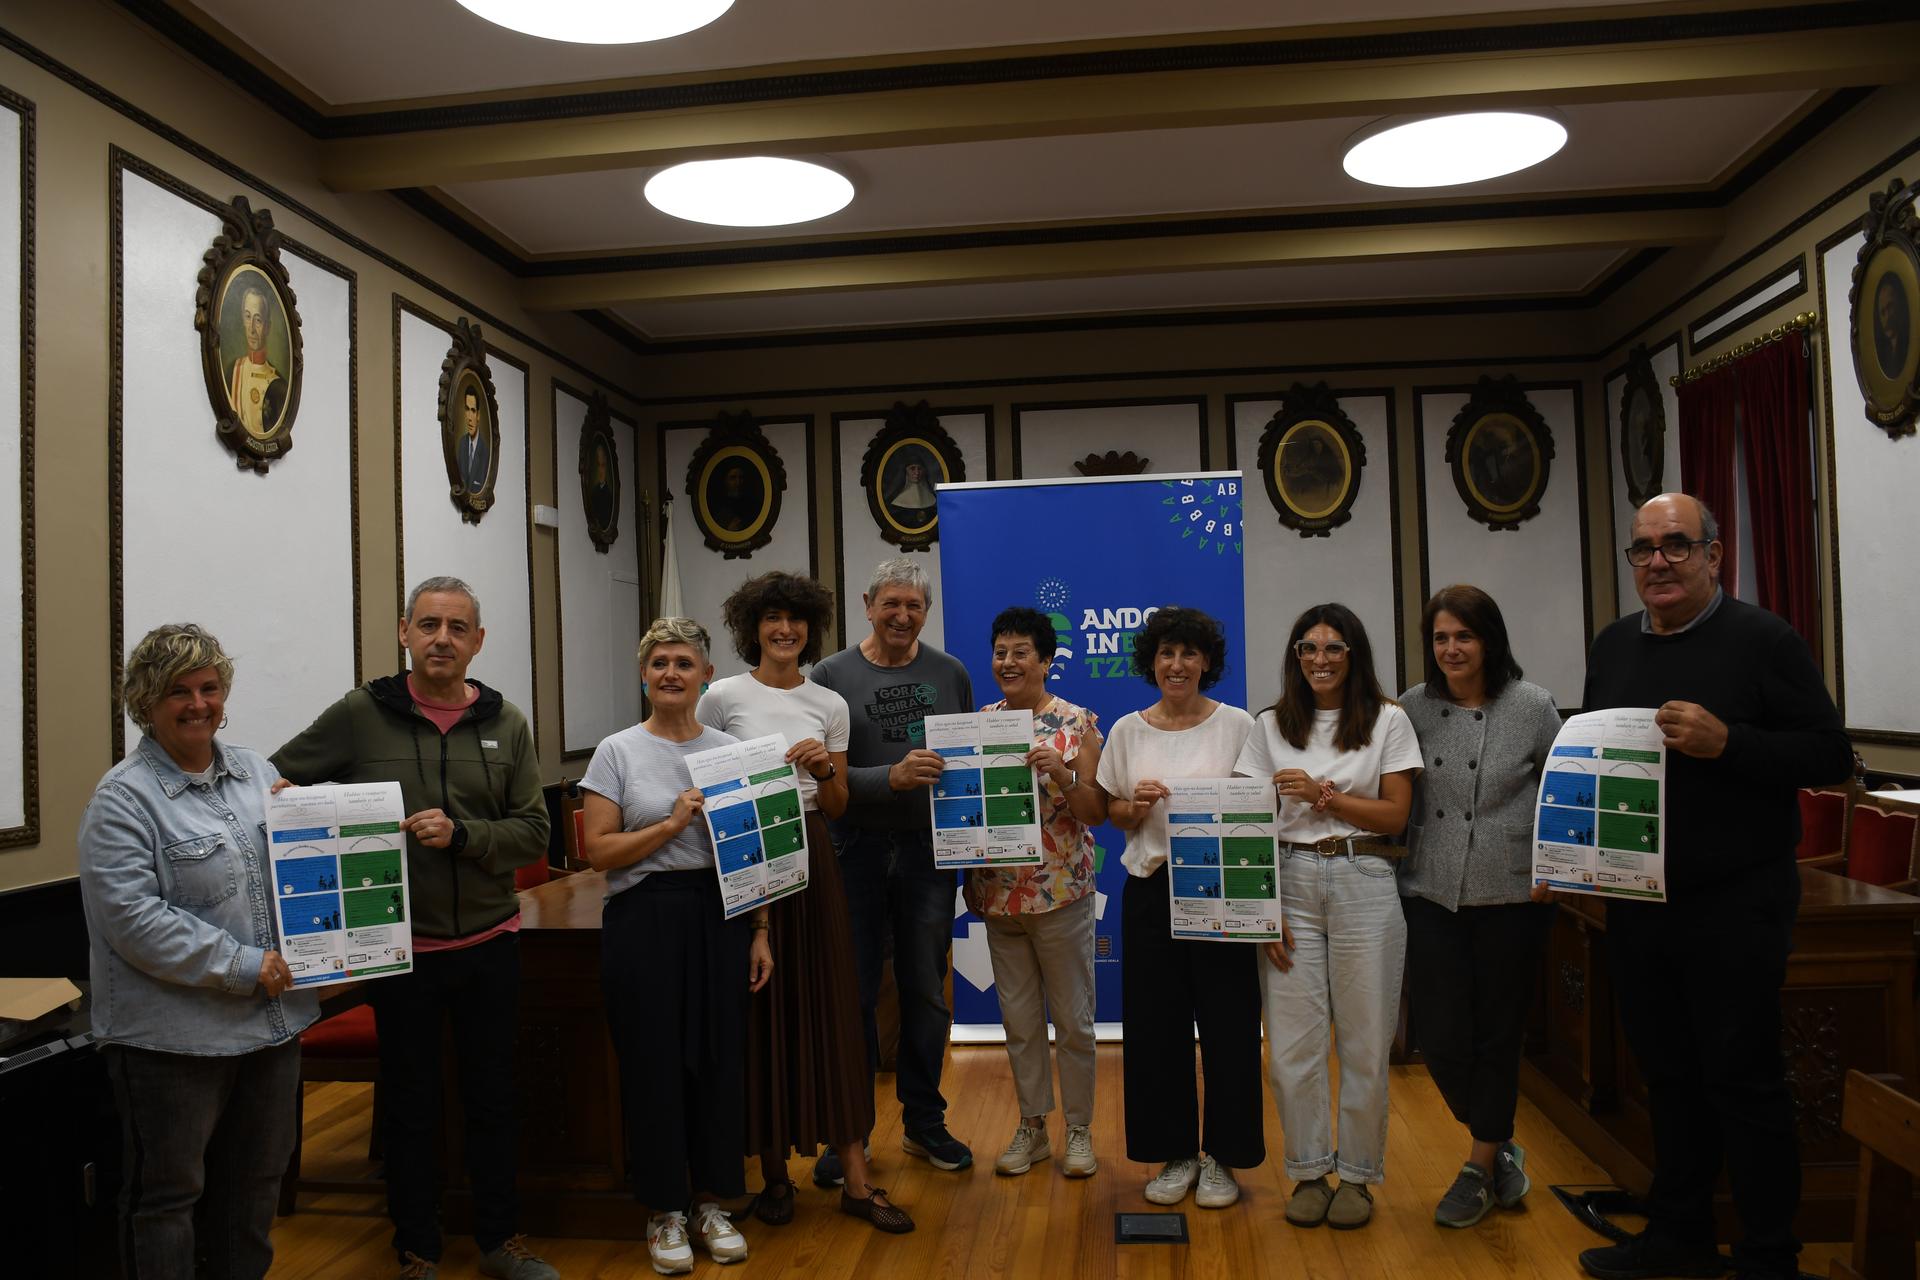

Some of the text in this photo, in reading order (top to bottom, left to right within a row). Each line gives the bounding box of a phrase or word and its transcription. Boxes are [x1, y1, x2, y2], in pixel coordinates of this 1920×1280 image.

[1217, 482, 1237, 496] AB
[880, 685, 916, 699] GORA
[870, 698, 918, 714] BEGIRA
